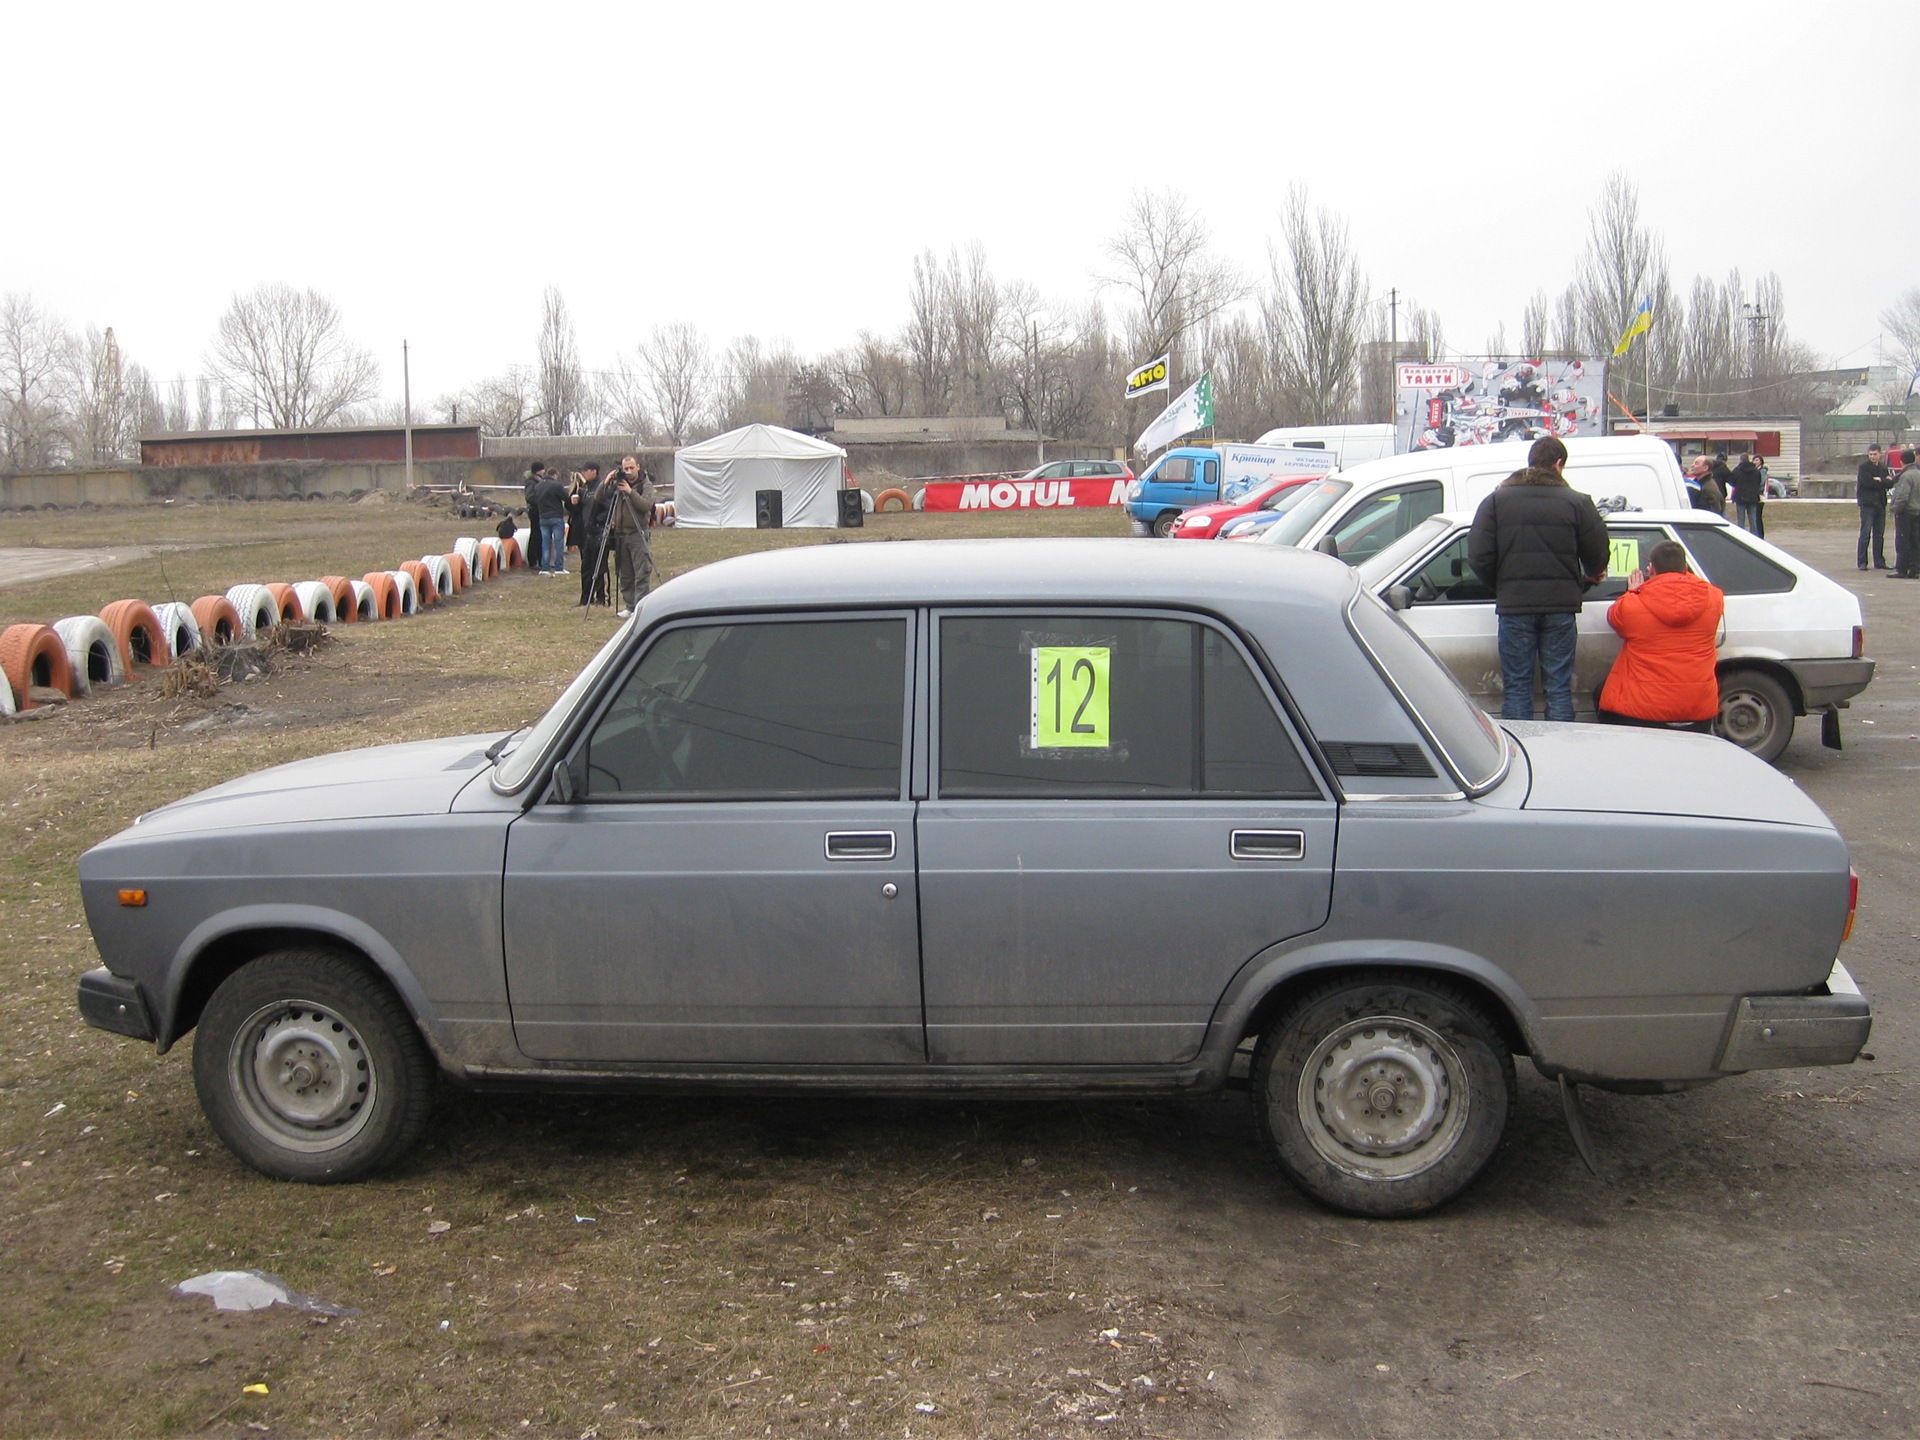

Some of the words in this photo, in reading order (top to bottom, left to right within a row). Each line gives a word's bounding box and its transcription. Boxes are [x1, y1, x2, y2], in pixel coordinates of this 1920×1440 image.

[959, 481, 1075, 509] MOTUL
[1613, 543, 1631, 572] 17
[1047, 658, 1096, 733] 12
